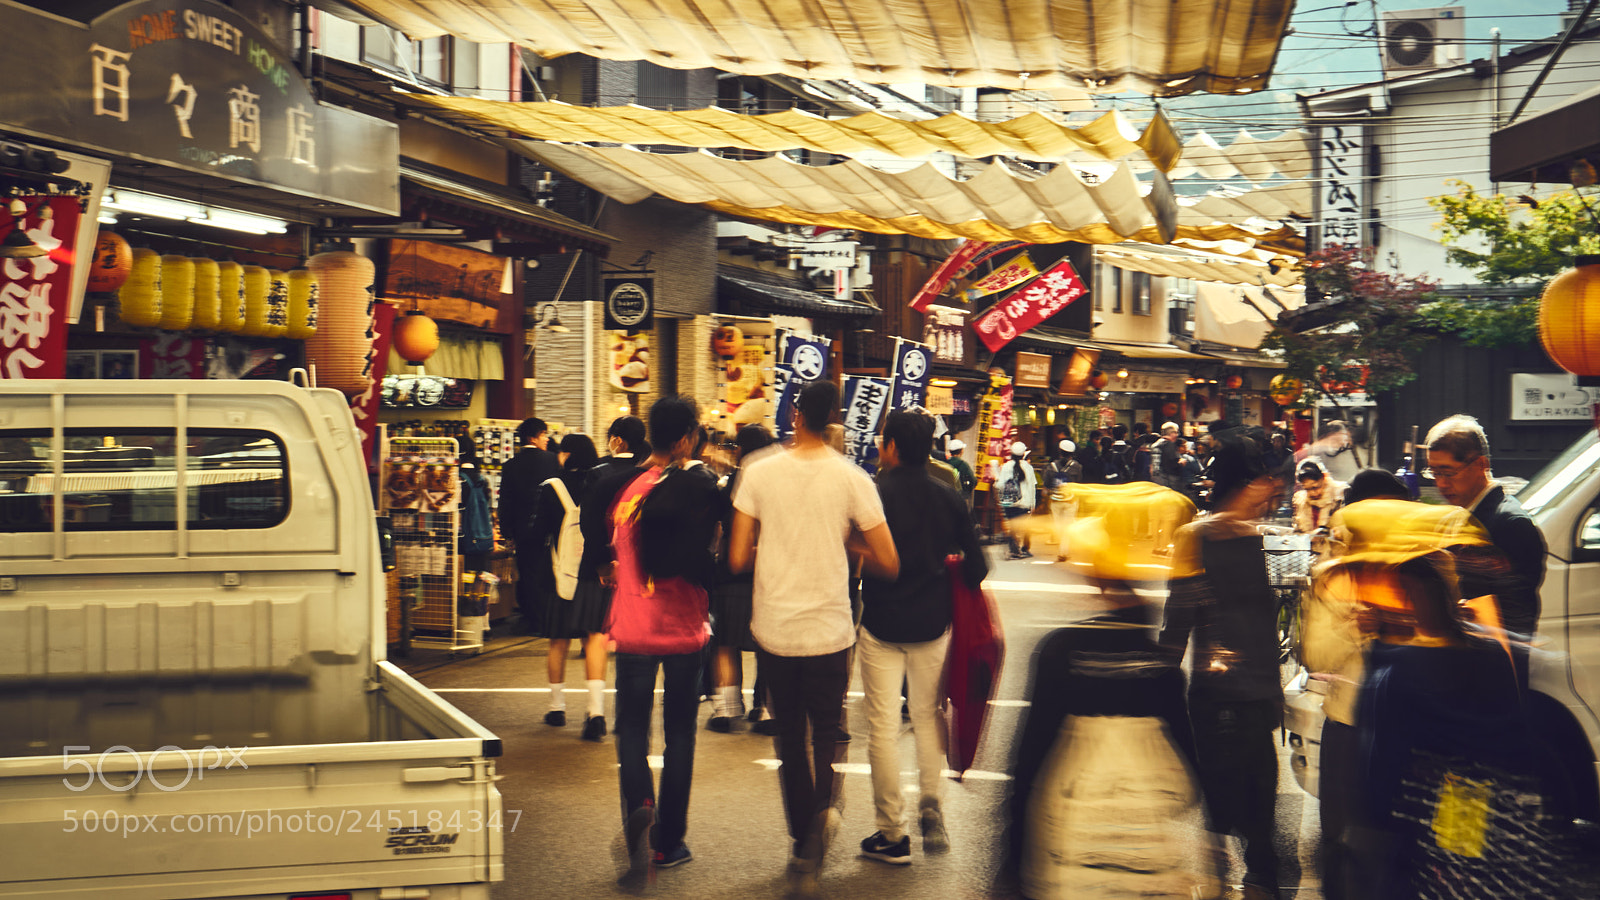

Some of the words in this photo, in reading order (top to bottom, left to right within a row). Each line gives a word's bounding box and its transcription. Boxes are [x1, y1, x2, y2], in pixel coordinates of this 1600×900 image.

[128, 10, 180, 49] HOME
[184, 9, 244, 55] SWEET
[247, 38, 290, 96] HOME
[88, 43, 319, 173] 百々商店
[1523, 407, 1592, 417] KURAYAD
[384, 833, 460, 850] SCRUM
